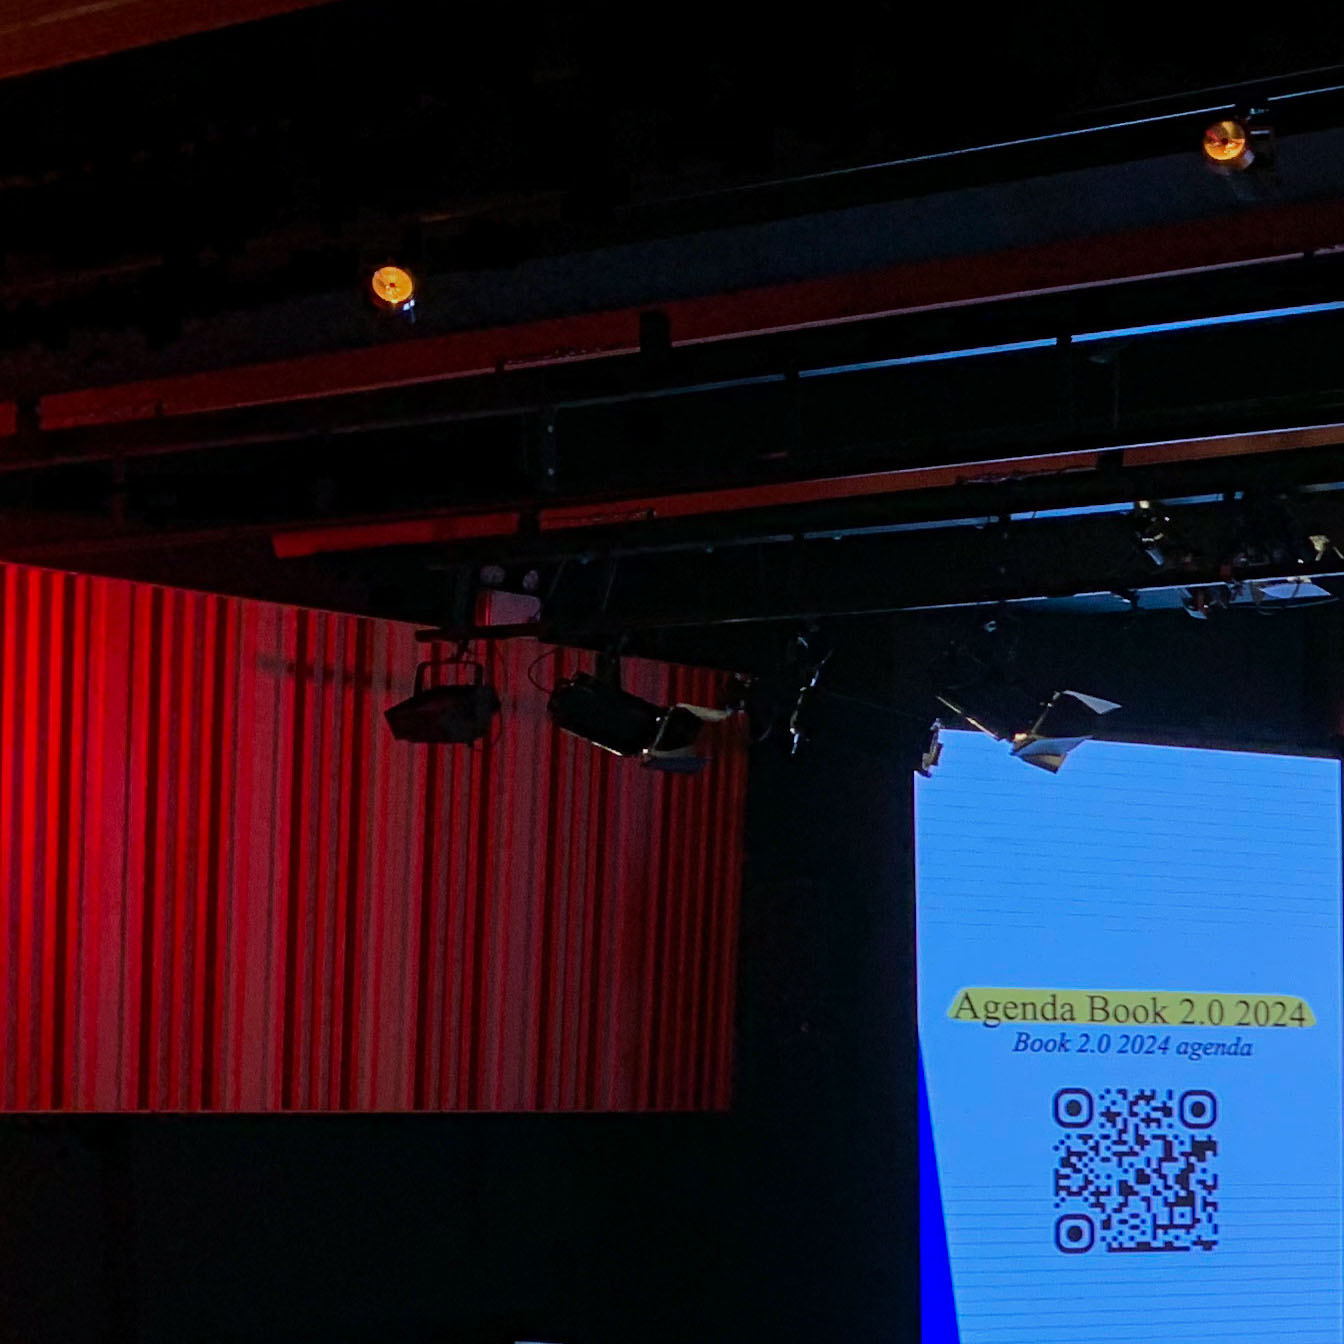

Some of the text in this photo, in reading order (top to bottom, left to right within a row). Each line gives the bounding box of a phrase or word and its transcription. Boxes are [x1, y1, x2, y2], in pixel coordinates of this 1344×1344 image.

[954, 991, 1306, 1029] Agenda Book 2.0 2024
[1012, 1032, 1253, 1061] Book 2.0 2024 agenda
